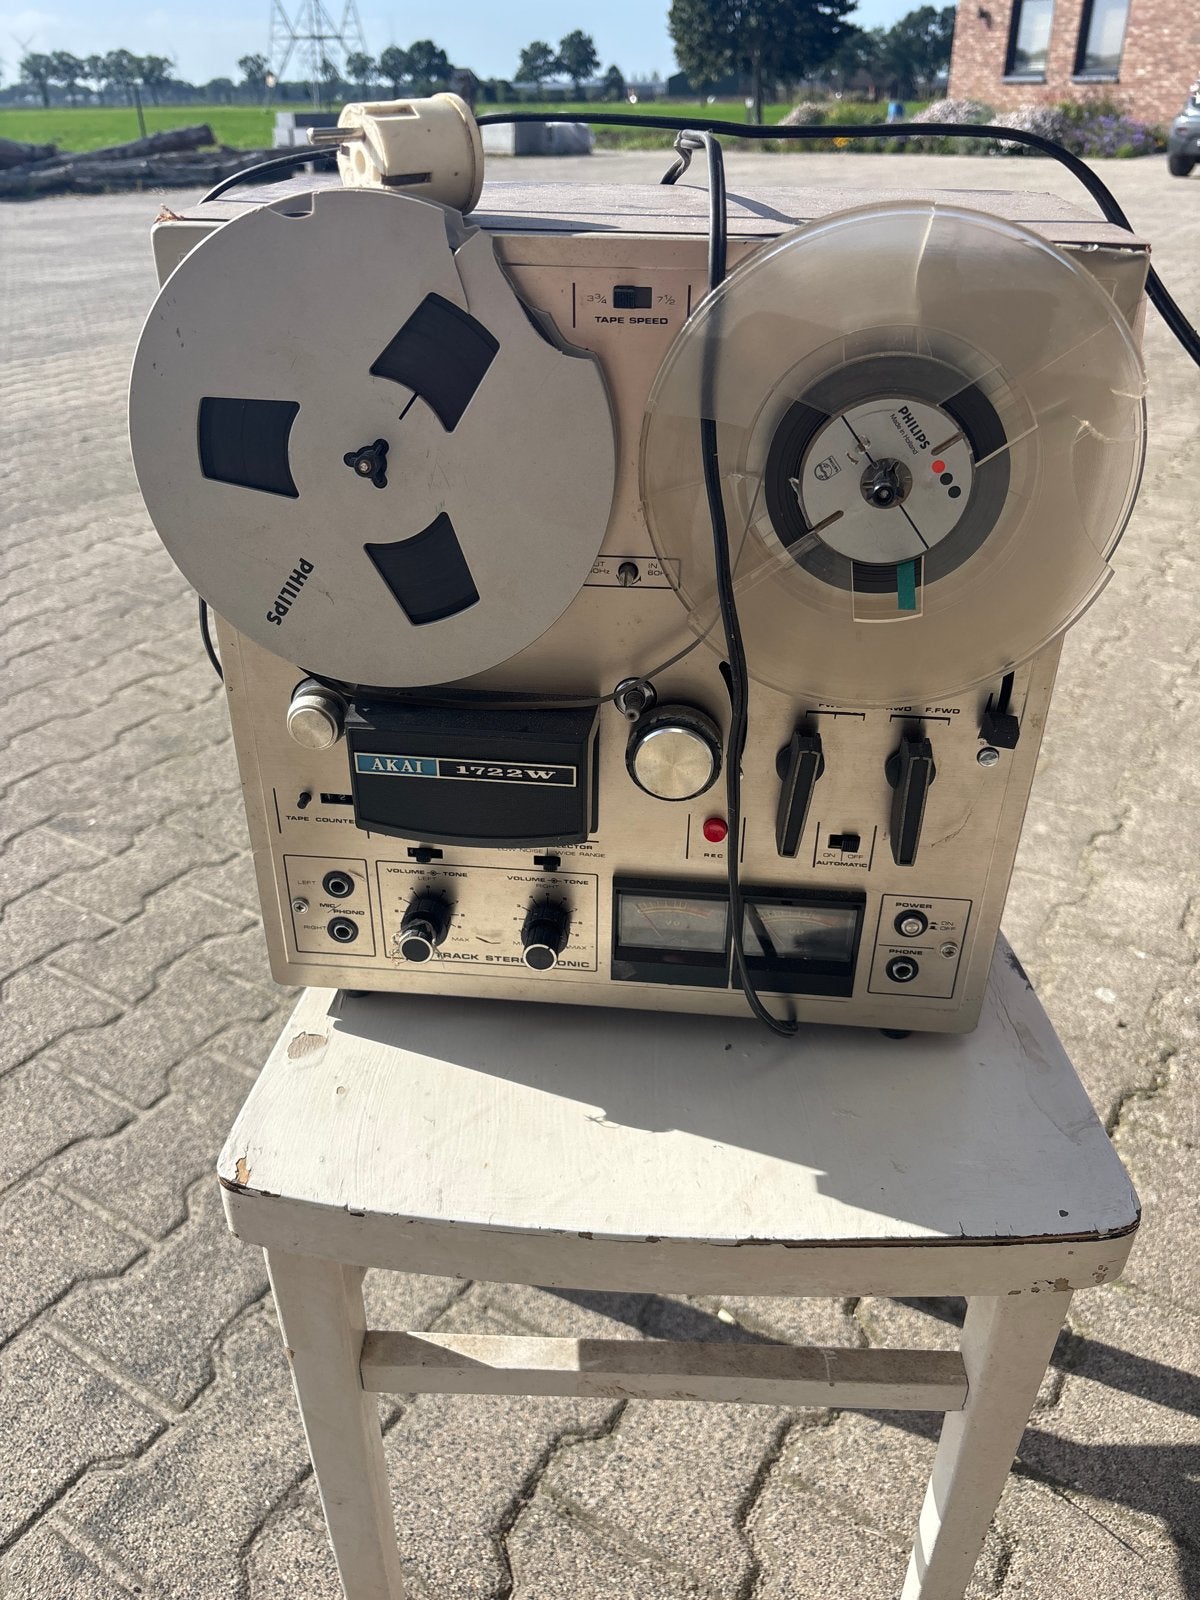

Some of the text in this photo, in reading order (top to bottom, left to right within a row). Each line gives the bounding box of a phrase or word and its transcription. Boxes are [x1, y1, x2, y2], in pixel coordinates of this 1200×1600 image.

[595, 316, 669, 325] TAPE SPEED
[898, 406, 930, 449] PHILIPS
[266, 557, 314, 626] PHILIPS
[925, 706, 960, 715] F.FWD
[371, 757, 557, 780] AKAI 1722W
[816, 860, 868, 868] AUTOMATIC
[888, 948, 923, 956] PHONE
